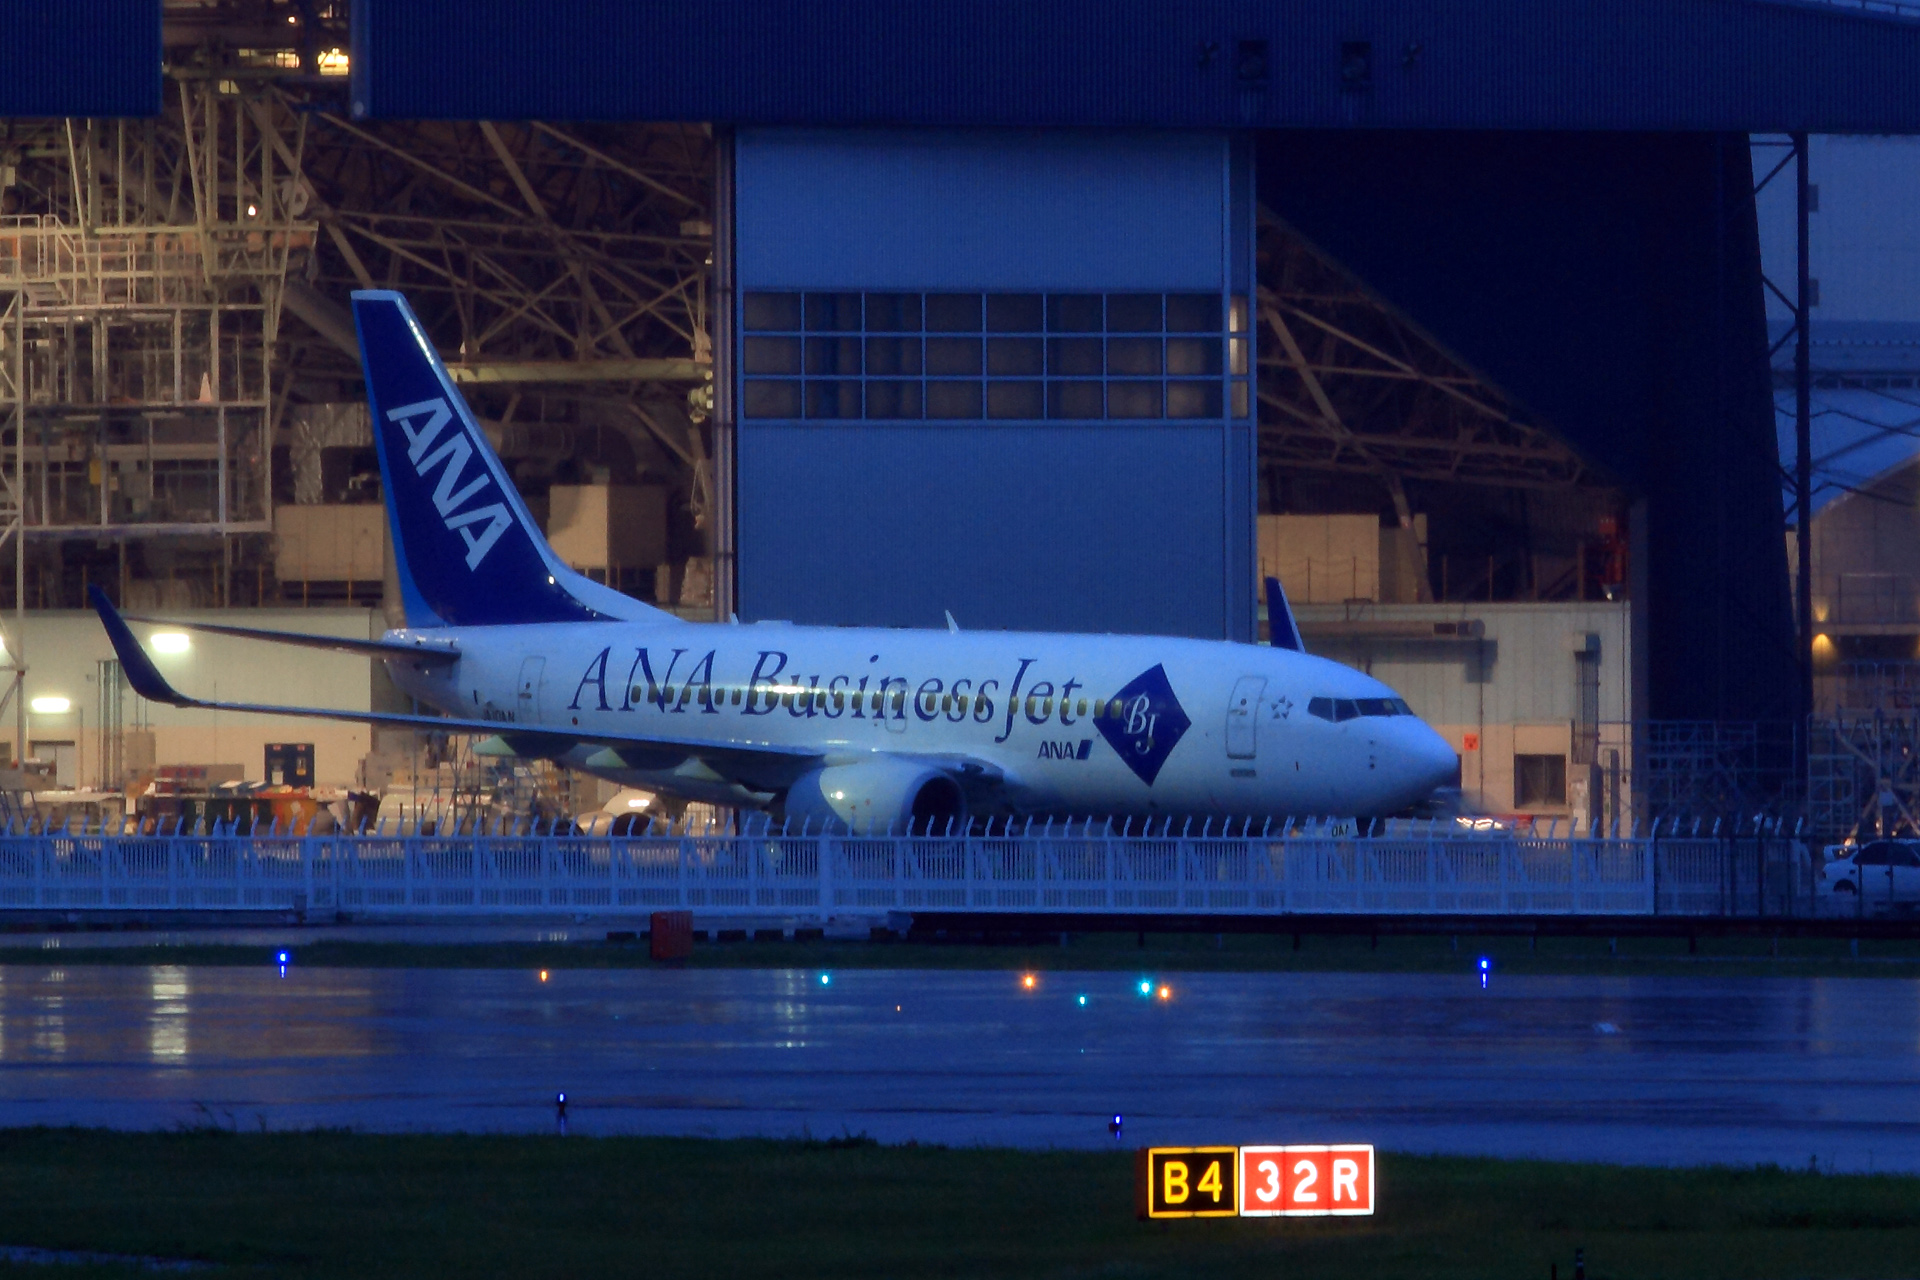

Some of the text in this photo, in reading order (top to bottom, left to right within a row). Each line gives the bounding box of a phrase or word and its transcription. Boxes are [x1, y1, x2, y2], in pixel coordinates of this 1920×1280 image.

[386, 397, 513, 572] ANA
[567, 646, 720, 714] ANA
[1037, 740, 1075, 760] ANA
[1163, 1160, 1223, 1204] B4
[1255, 1158, 1359, 1203] 32R
